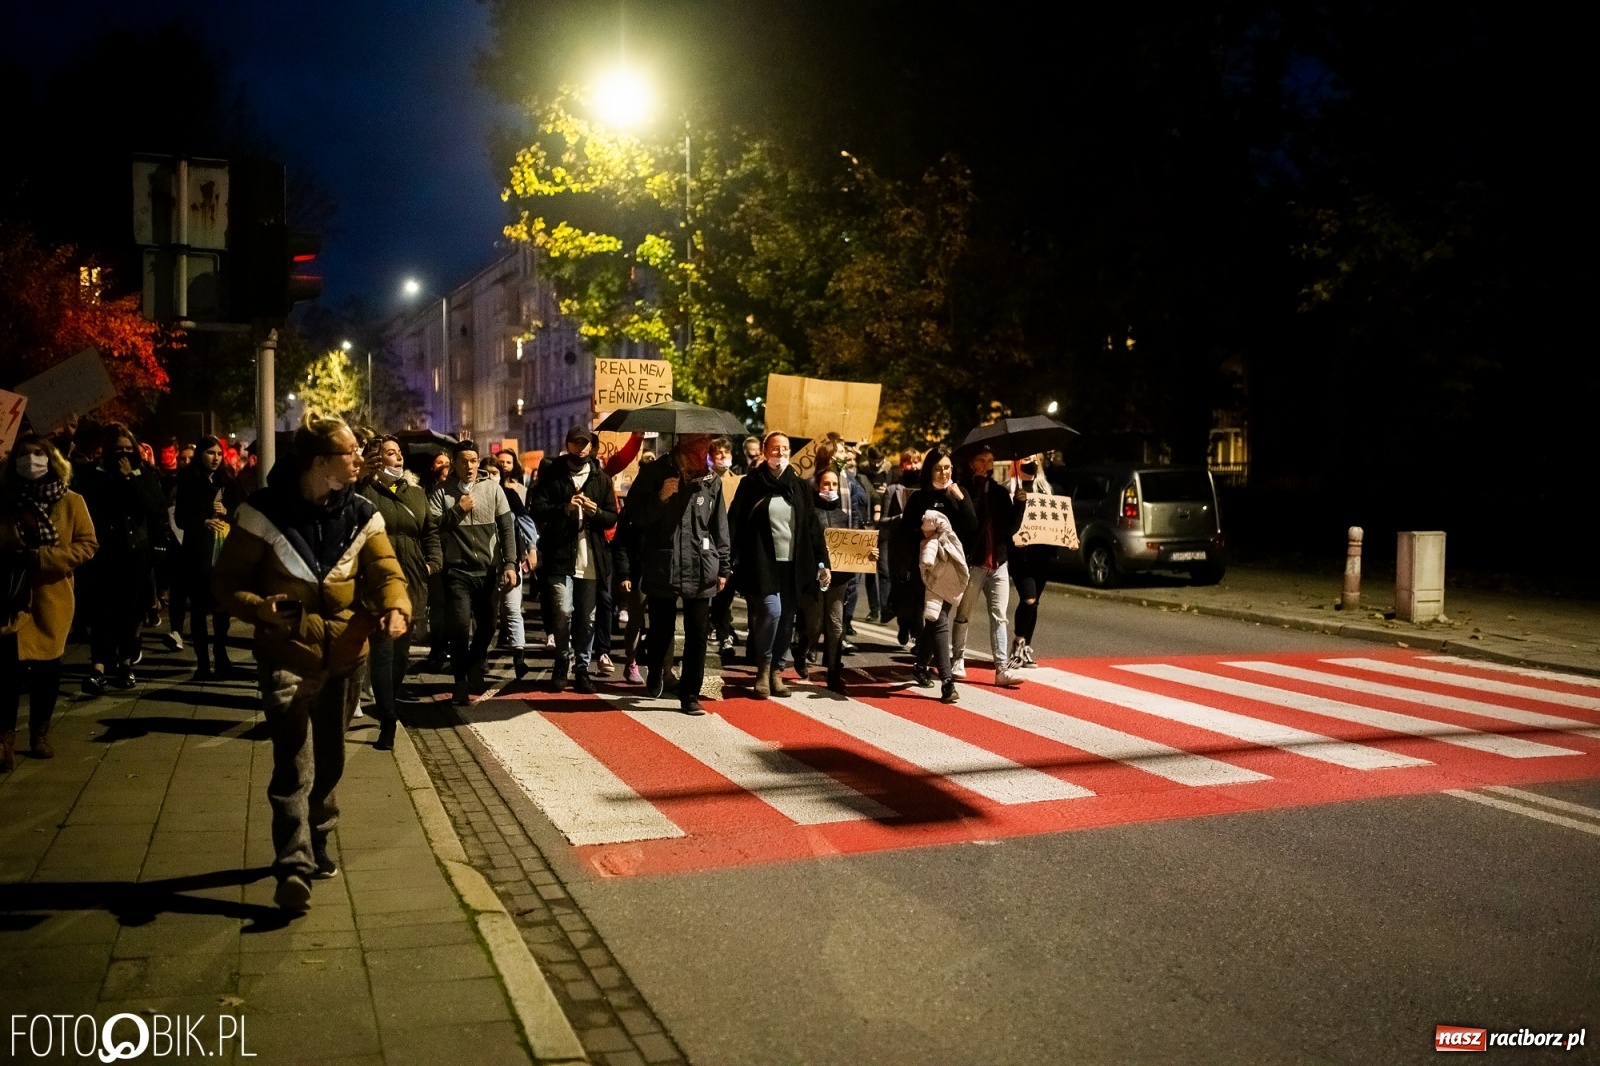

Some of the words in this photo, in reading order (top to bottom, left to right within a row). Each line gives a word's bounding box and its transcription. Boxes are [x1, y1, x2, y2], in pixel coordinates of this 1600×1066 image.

[600, 361, 636, 375] REAL
[640, 363, 666, 379] MEN
[613, 377, 649, 391] ARE
